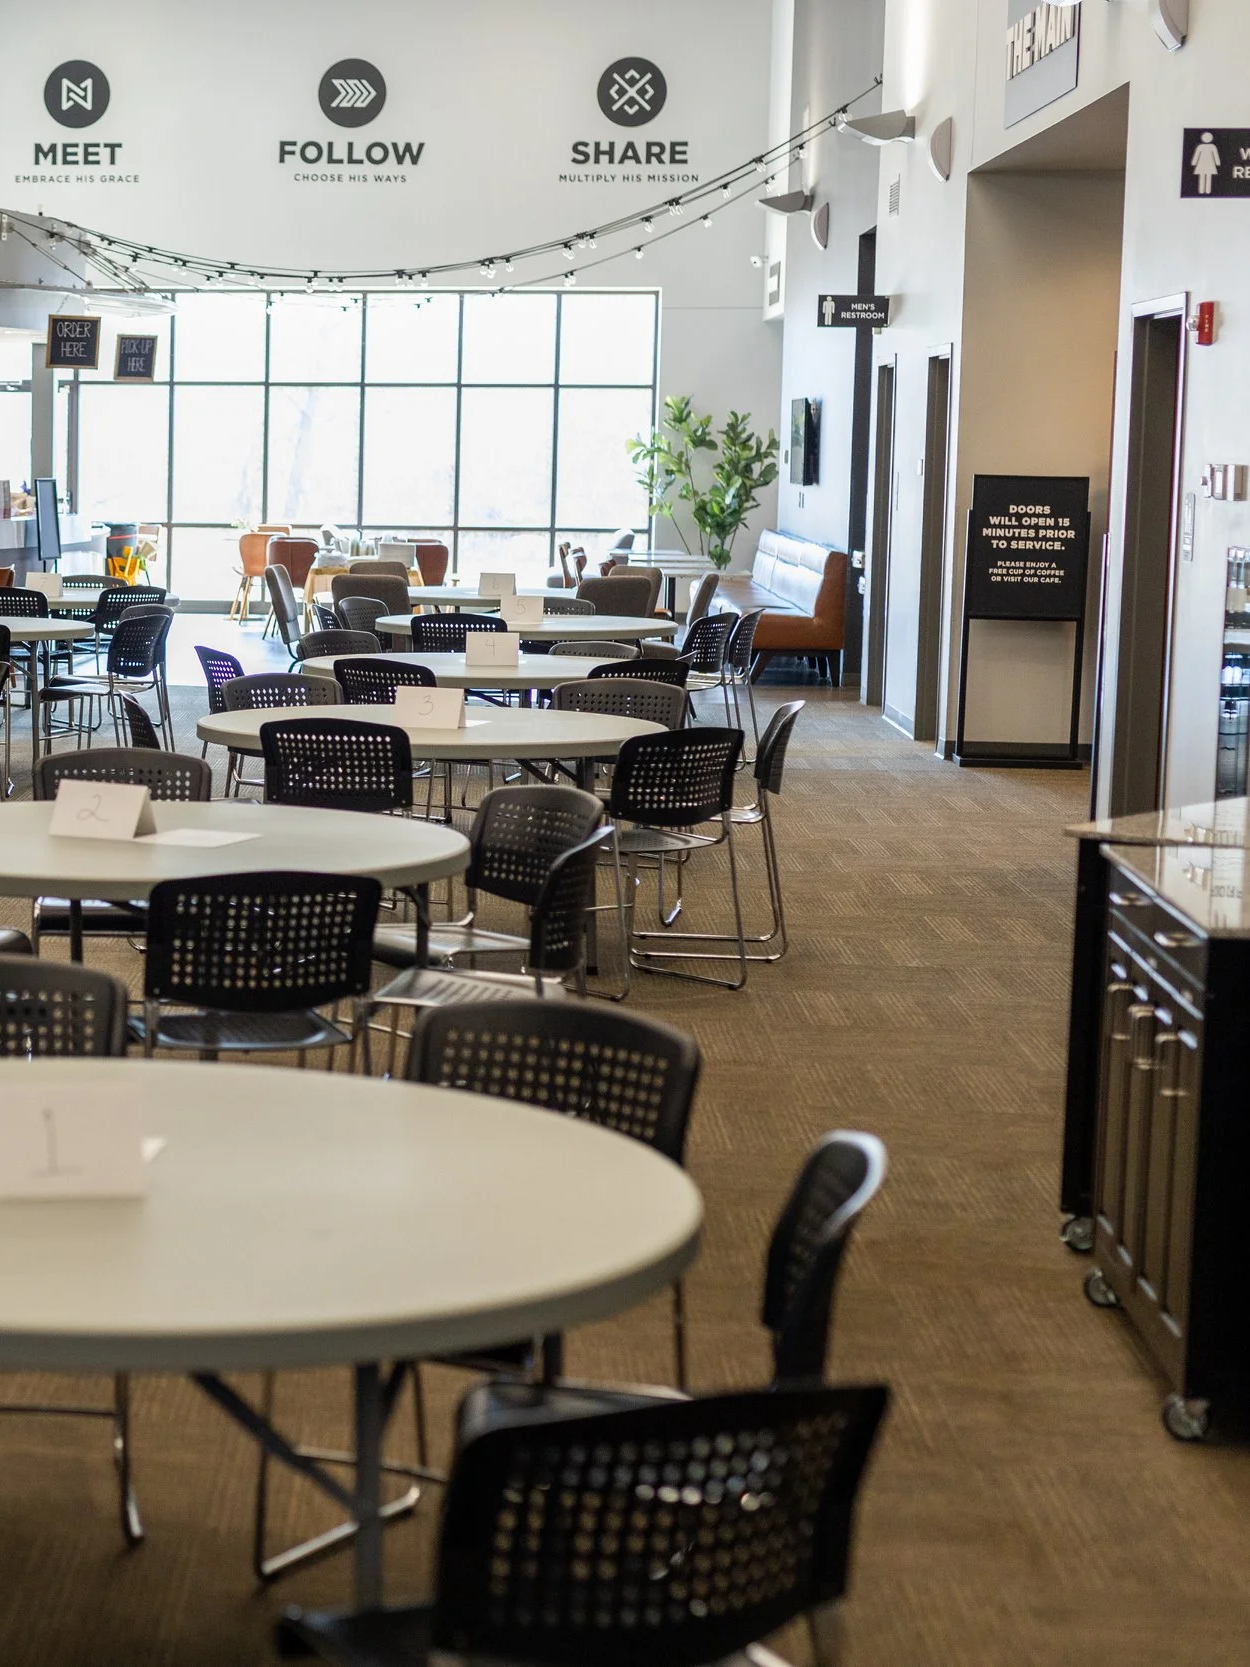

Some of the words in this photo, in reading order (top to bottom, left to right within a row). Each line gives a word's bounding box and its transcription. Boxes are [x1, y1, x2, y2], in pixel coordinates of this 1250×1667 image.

[1006, 11, 1034, 81] THE
[34, 142, 123, 165] MEET
[279, 141, 426, 166] FOLLOW
[570, 140, 689, 165] SHARE
[14, 175, 70, 183] EMBRACE
[76, 175, 95, 183] HIS
[100, 175, 140, 183] GRACE
[293, 173, 344, 183] CHOOSE
[349, 174, 368, 183] HIS
[373, 175, 407, 183] WAYS
[558, 174, 617, 183] MULTIPLY
[622, 174, 642, 183] HIS
[647, 174, 700, 183] MISSION
[840, 311, 885, 319] RESTROOM
[851, 303, 876, 311] MEN'S
[56, 321, 91, 338] ORDER
[60, 341, 87, 357] HERE
[121, 339, 153, 355] PICK-UP
[127, 356, 146, 372] HERE
[1009, 505, 1051, 514] DOORS
[989, 516, 1019, 525] WILL
[1022, 517, 1054, 526] OPEN
[1057, 518, 1070, 527] 15
[982, 528, 1036, 537] MINUTES
[1038, 529, 1076, 539] PRIOR
[991, 540, 1008, 549] TO
[1010, 540, 1066, 550] SERVICE.
[514, 598, 526, 615] 5
[485, 638, 496, 657] 4
[418, 694, 434, 716] 3
[76, 793, 110, 822] 2
